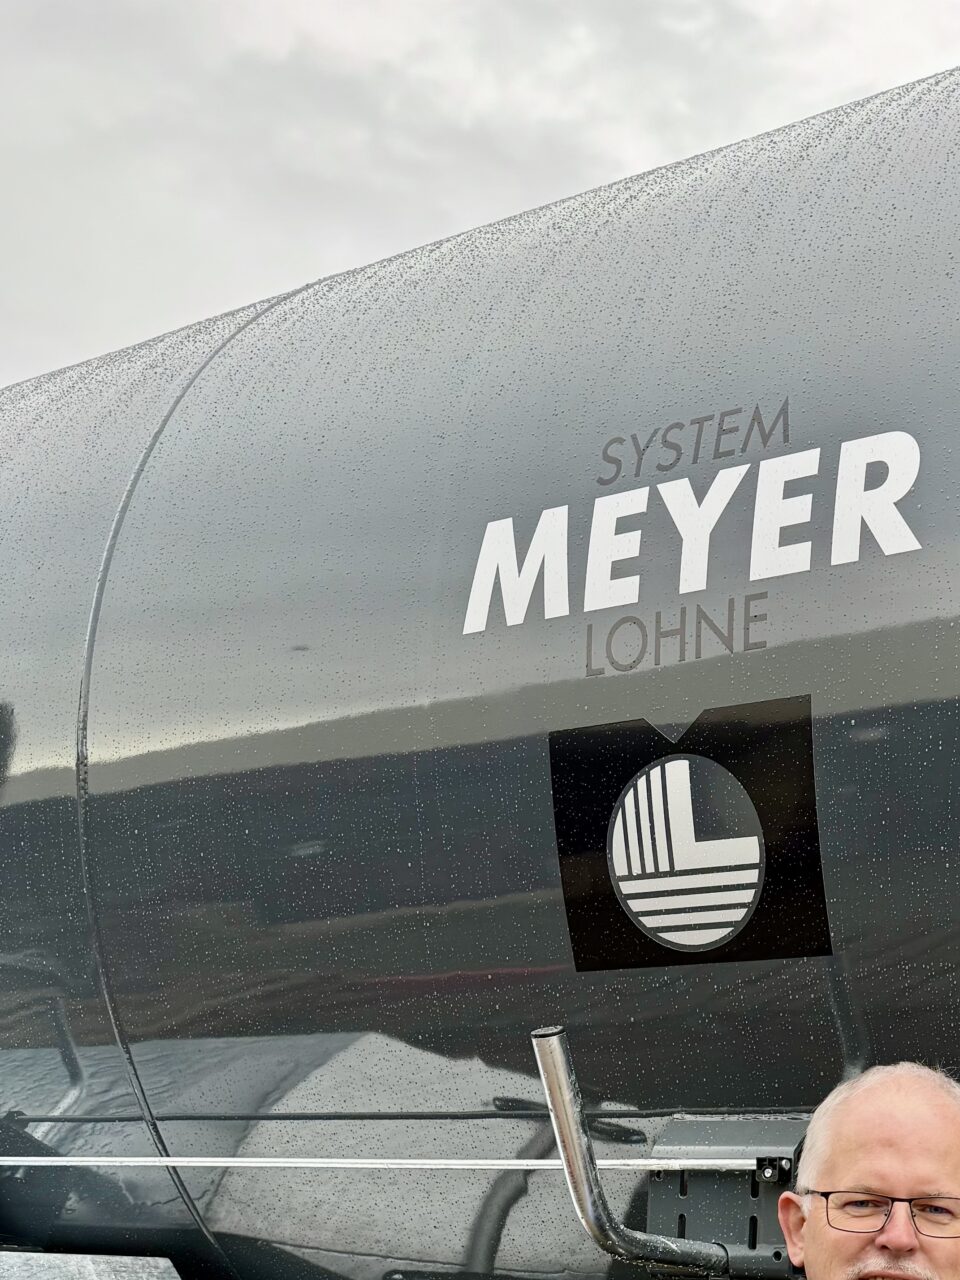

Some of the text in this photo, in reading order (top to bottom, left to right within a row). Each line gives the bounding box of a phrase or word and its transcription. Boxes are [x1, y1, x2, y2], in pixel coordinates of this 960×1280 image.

[596, 395, 791, 486] SYSTEM
[462, 430, 923, 635] MEYER
[585, 591, 769, 677] LOHNE
